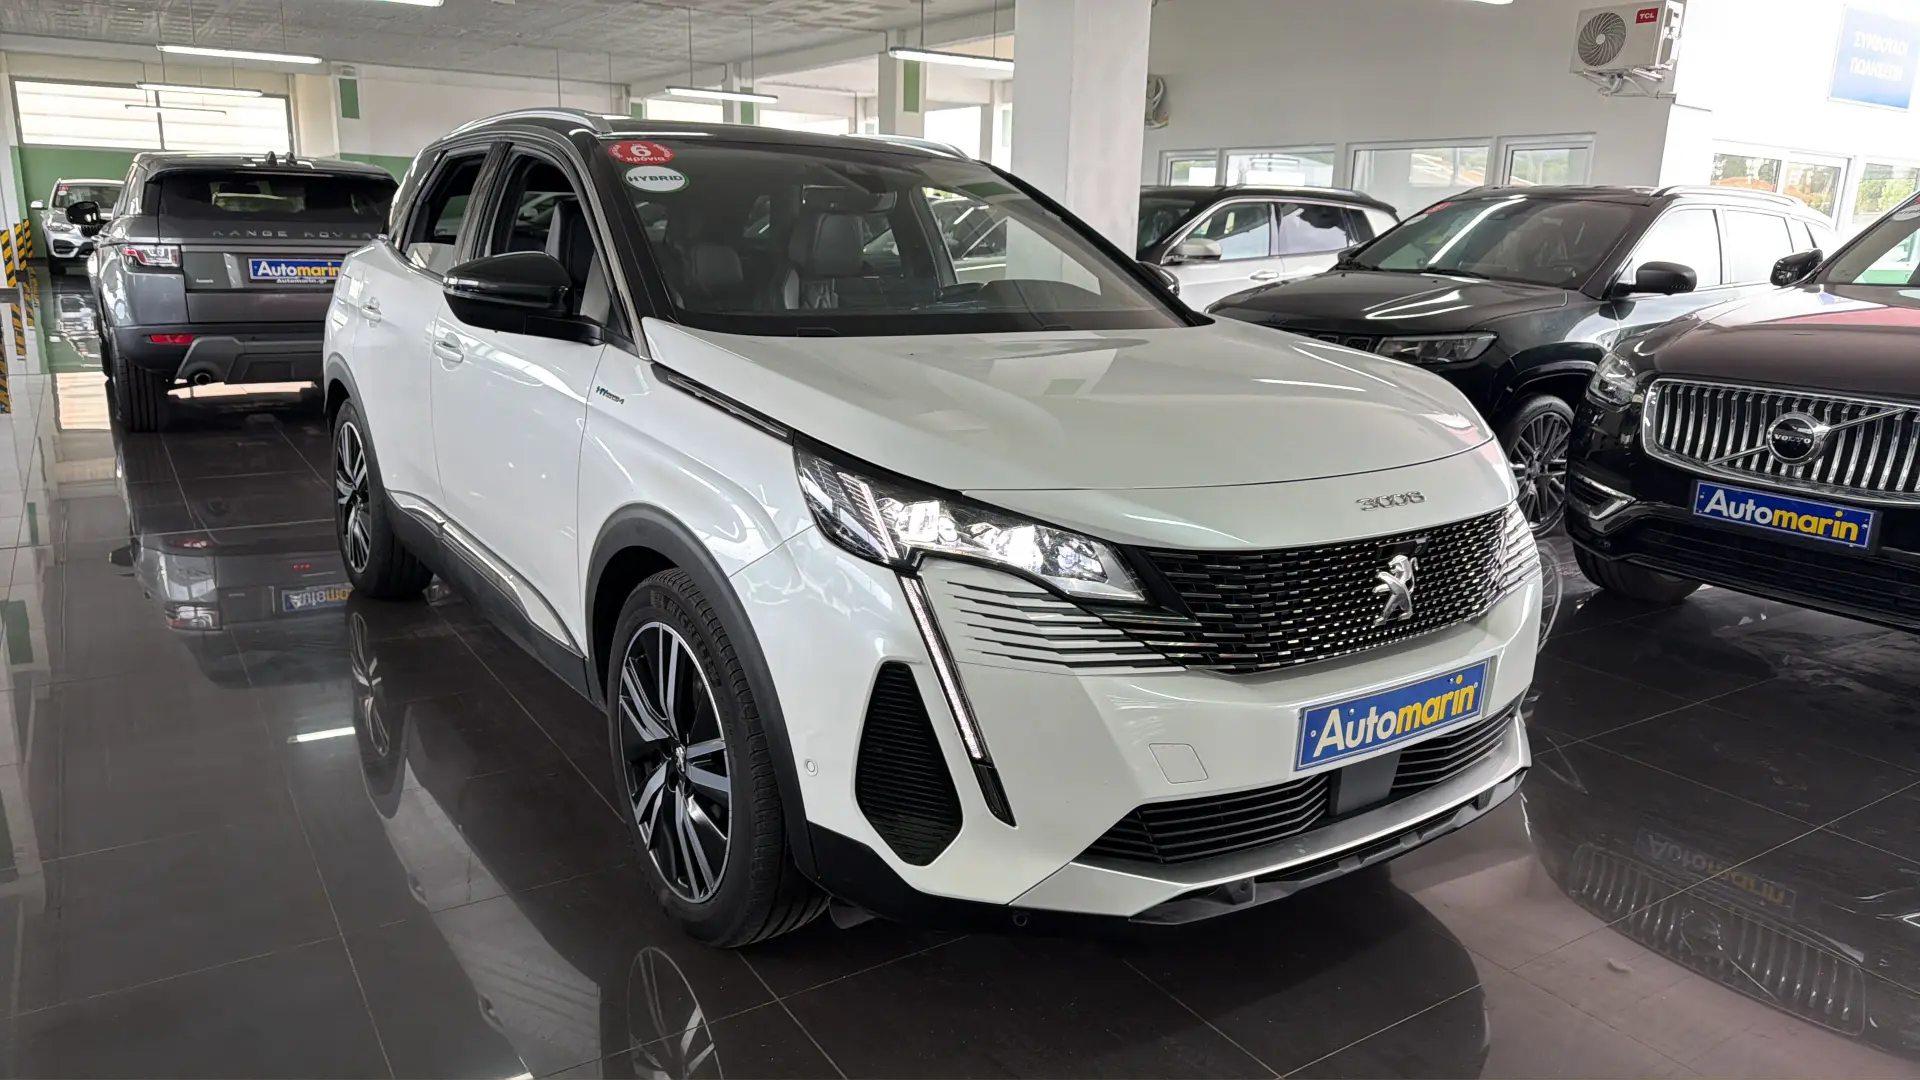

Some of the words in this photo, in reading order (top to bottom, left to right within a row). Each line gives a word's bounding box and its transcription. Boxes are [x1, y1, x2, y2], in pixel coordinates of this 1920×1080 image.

[630, 145, 652, 157] 6
[1774, 433, 1812, 444] VOLVO
[1355, 490, 1426, 511] 3008
[1704, 489, 1859, 541] Automarin
[1312, 674, 1476, 757] Automarin
